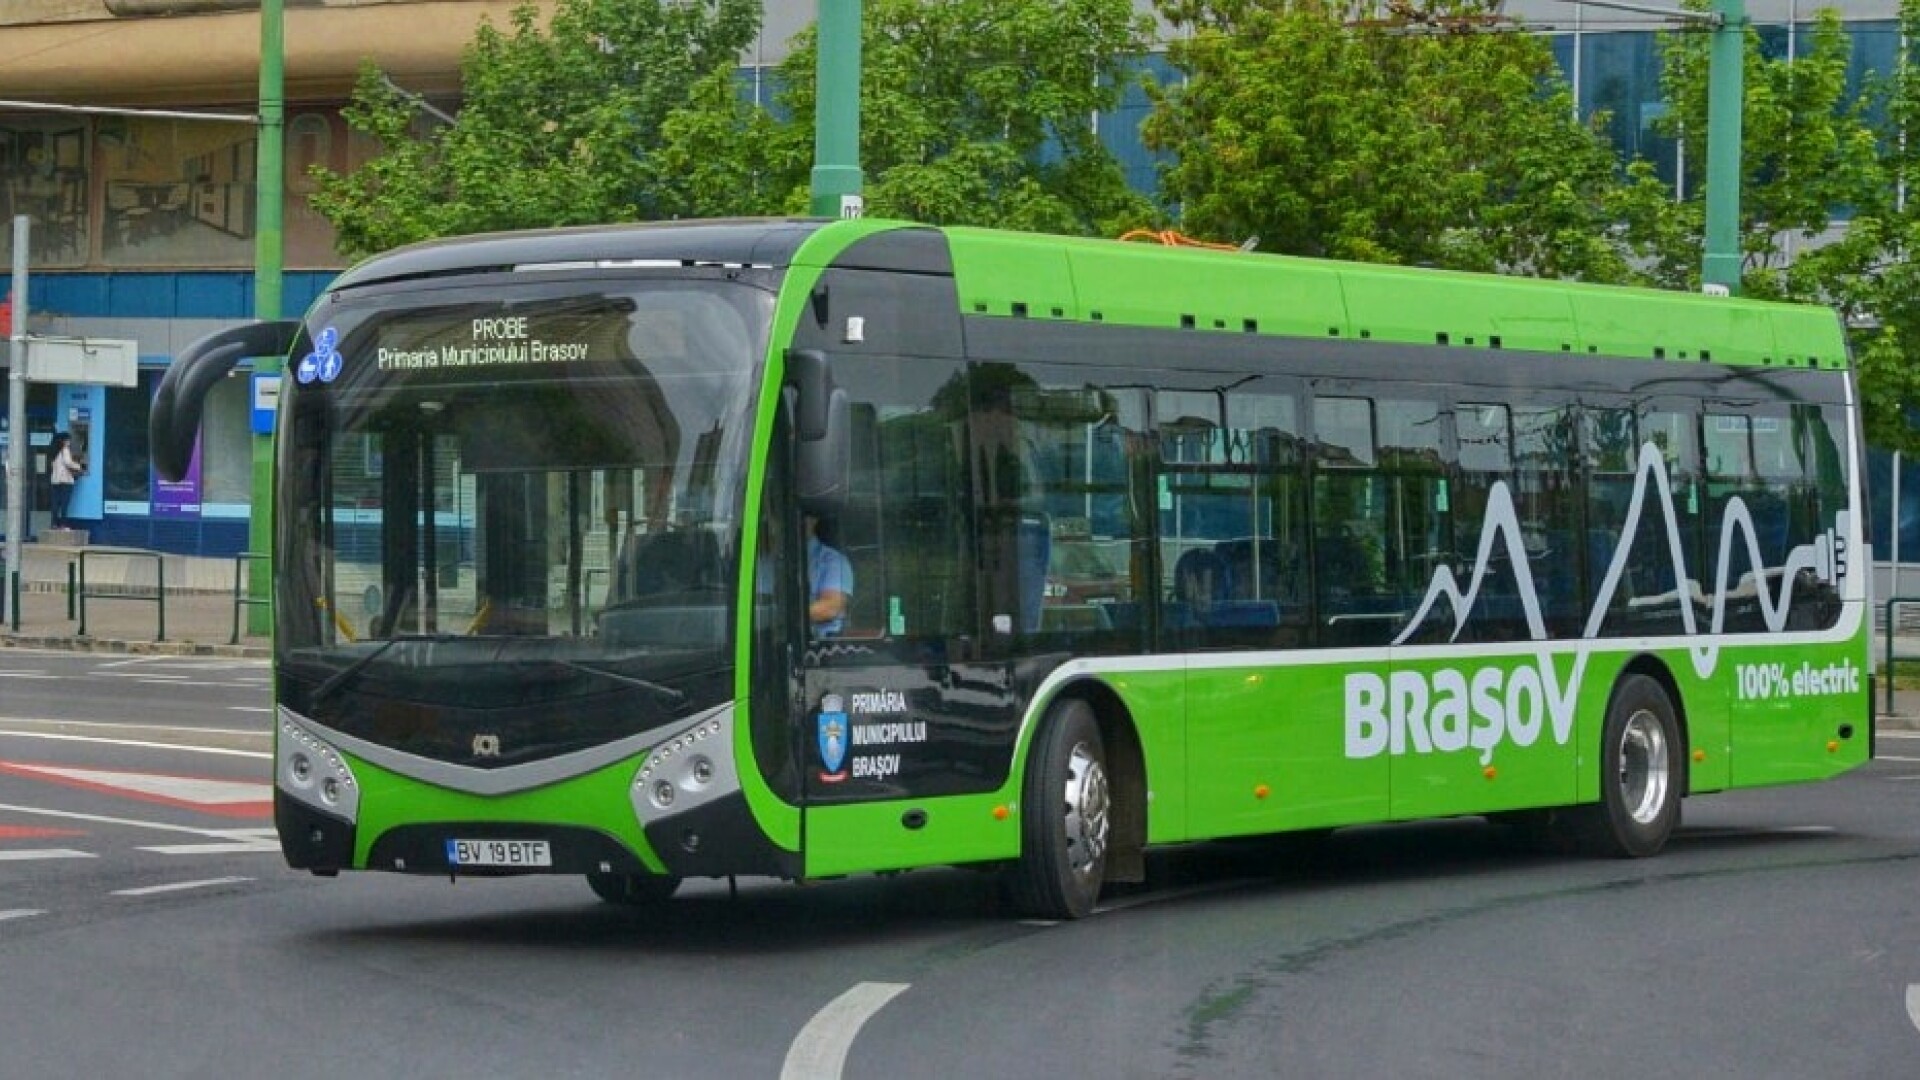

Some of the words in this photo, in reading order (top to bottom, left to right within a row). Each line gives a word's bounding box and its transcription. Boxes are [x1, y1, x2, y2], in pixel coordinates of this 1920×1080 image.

[472, 316, 528, 340] PROBE
[378, 347, 439, 370] Primaria
[442, 341, 528, 366] Municipiului
[531, 339, 588, 362] Brasov
[1736, 662, 1790, 700] 100%
[1792, 657, 1860, 696] electric
[457, 842, 480, 862] BV
[488, 843, 505, 862] 19
[509, 842, 545, 863] BTF
